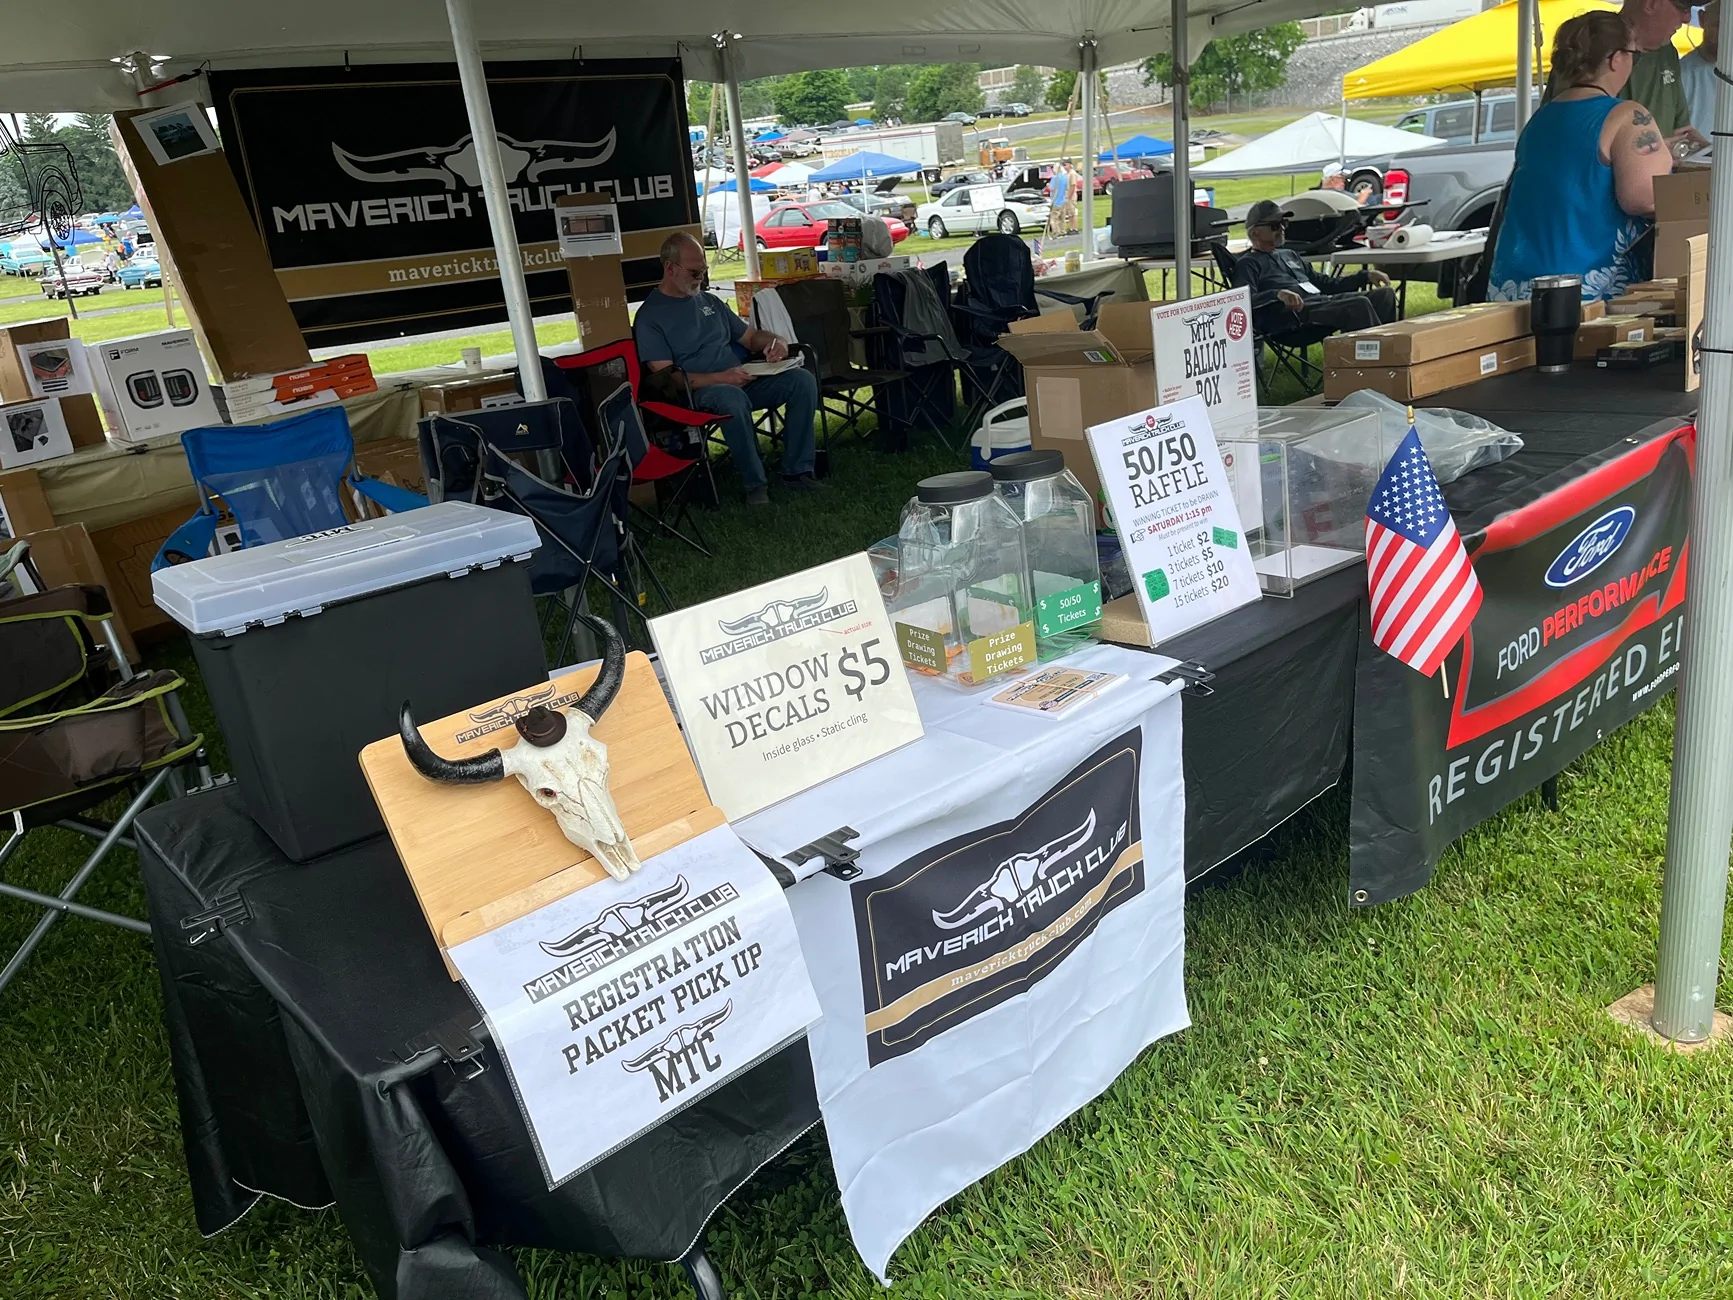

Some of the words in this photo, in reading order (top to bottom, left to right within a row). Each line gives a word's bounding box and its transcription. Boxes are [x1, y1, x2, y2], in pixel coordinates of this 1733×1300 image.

[272, 191, 472, 233] MAVERICK
[1156, 310, 1170, 320] VOTE
[1170, 308, 1180, 317] FOR
[1180, 305, 1194, 314] YOUR
[1194, 299, 1216, 311] FAVORITE
[1227, 292, 1245, 303] TRUCKS
[1231, 311, 1244, 325] VOTE
[1190, 320, 1215, 344] MTC
[1229, 324, 1243, 337] HERE
[1183, 338, 1227, 379] BALLOT
[1121, 431, 1151, 446] MAVERICK
[1150, 425, 1171, 438] TRUCK
[1170, 420, 1186, 431] CLUB
[1122, 432, 1197, 481] 50/50
[1129, 461, 1209, 508] RAFFLE
[1132, 511, 1161, 527] WINNING
[1161, 502, 1182, 517] TICKET
[1182, 500, 1190, 509] to
[1189, 497, 1198, 507] be
[1198, 490, 1219, 504] DRAWN
[1147, 514, 1184, 534] SATURDAY
[1185, 508, 1201, 521] 1:15
[1201, 504, 1213, 517] pm
[1158, 530, 1170, 541] Must
[1169, 528, 1177, 537] be
[1167, 546, 1174, 557] 1
[1174, 538, 1196, 555] ticket
[1197, 531, 1210, 546] $2
[1563, 519, 1623, 576] Ford
[1168, 564, 1175, 575] 3
[1174, 554, 1201, 572] tickets
[1202, 547, 1214, 562] $5
[1173, 579, 1179, 590] 7
[1180, 570, 1205, 588] tickets
[1206, 560, 1225, 578] $10
[1059, 594, 1082, 609] 50/50
[1174, 595, 1184, 608] 15
[1184, 586, 1210, 604] tickets
[1211, 575, 1230, 593] $20
[701, 629, 775, 664] MAVERICK
[777, 613, 820, 638] TRUCK
[822, 601, 857, 623] CLUB
[843, 622, 862, 635] actual
[862, 619, 873, 630] size
[909, 628, 930, 641] Prize
[1057, 609, 1087, 624] Tickets
[907, 640, 936, 657] Drawing
[985, 641, 1023, 663] Drawing
[989, 630, 1016, 647] Prize
[1496, 626, 1540, 680] FORD
[837, 637, 891, 702] $5
[908, 651, 937, 668] Tickets
[987, 655, 1024, 676] Tickets
[699, 652, 830, 721] WINDOW
[1632, 661, 1680, 702] WWW.FORDPERFO
[457, 717, 514, 743] MAVERICK
[551, 692, 579, 709] CLUB
[725, 688, 831, 749] DECALS
[1428, 643, 1647, 826] REGISTERED
[762, 741, 791, 762] Inside
[792, 733, 816, 754] glass
[820, 722, 847, 740] Static
[846, 711, 869, 732] cling
[885, 908, 1014, 981] MAVERICK
[1015, 861, 1084, 918] TRUCK
[1084, 820, 1127, 873] CLUB
[525, 940, 628, 1001] MAVERICK
[625, 909, 690, 948] TRUCK
[689, 884, 737, 917] CLUB
[951, 896, 1093, 986] mavericktruckclub.com
[562, 915, 742, 1032] REGISTRATION
[561, 995, 667, 1075] PACKET
[671, 961, 731, 1014] PICK
[731, 942, 762, 979] UP
[648, 1029, 722, 1104] MTC
